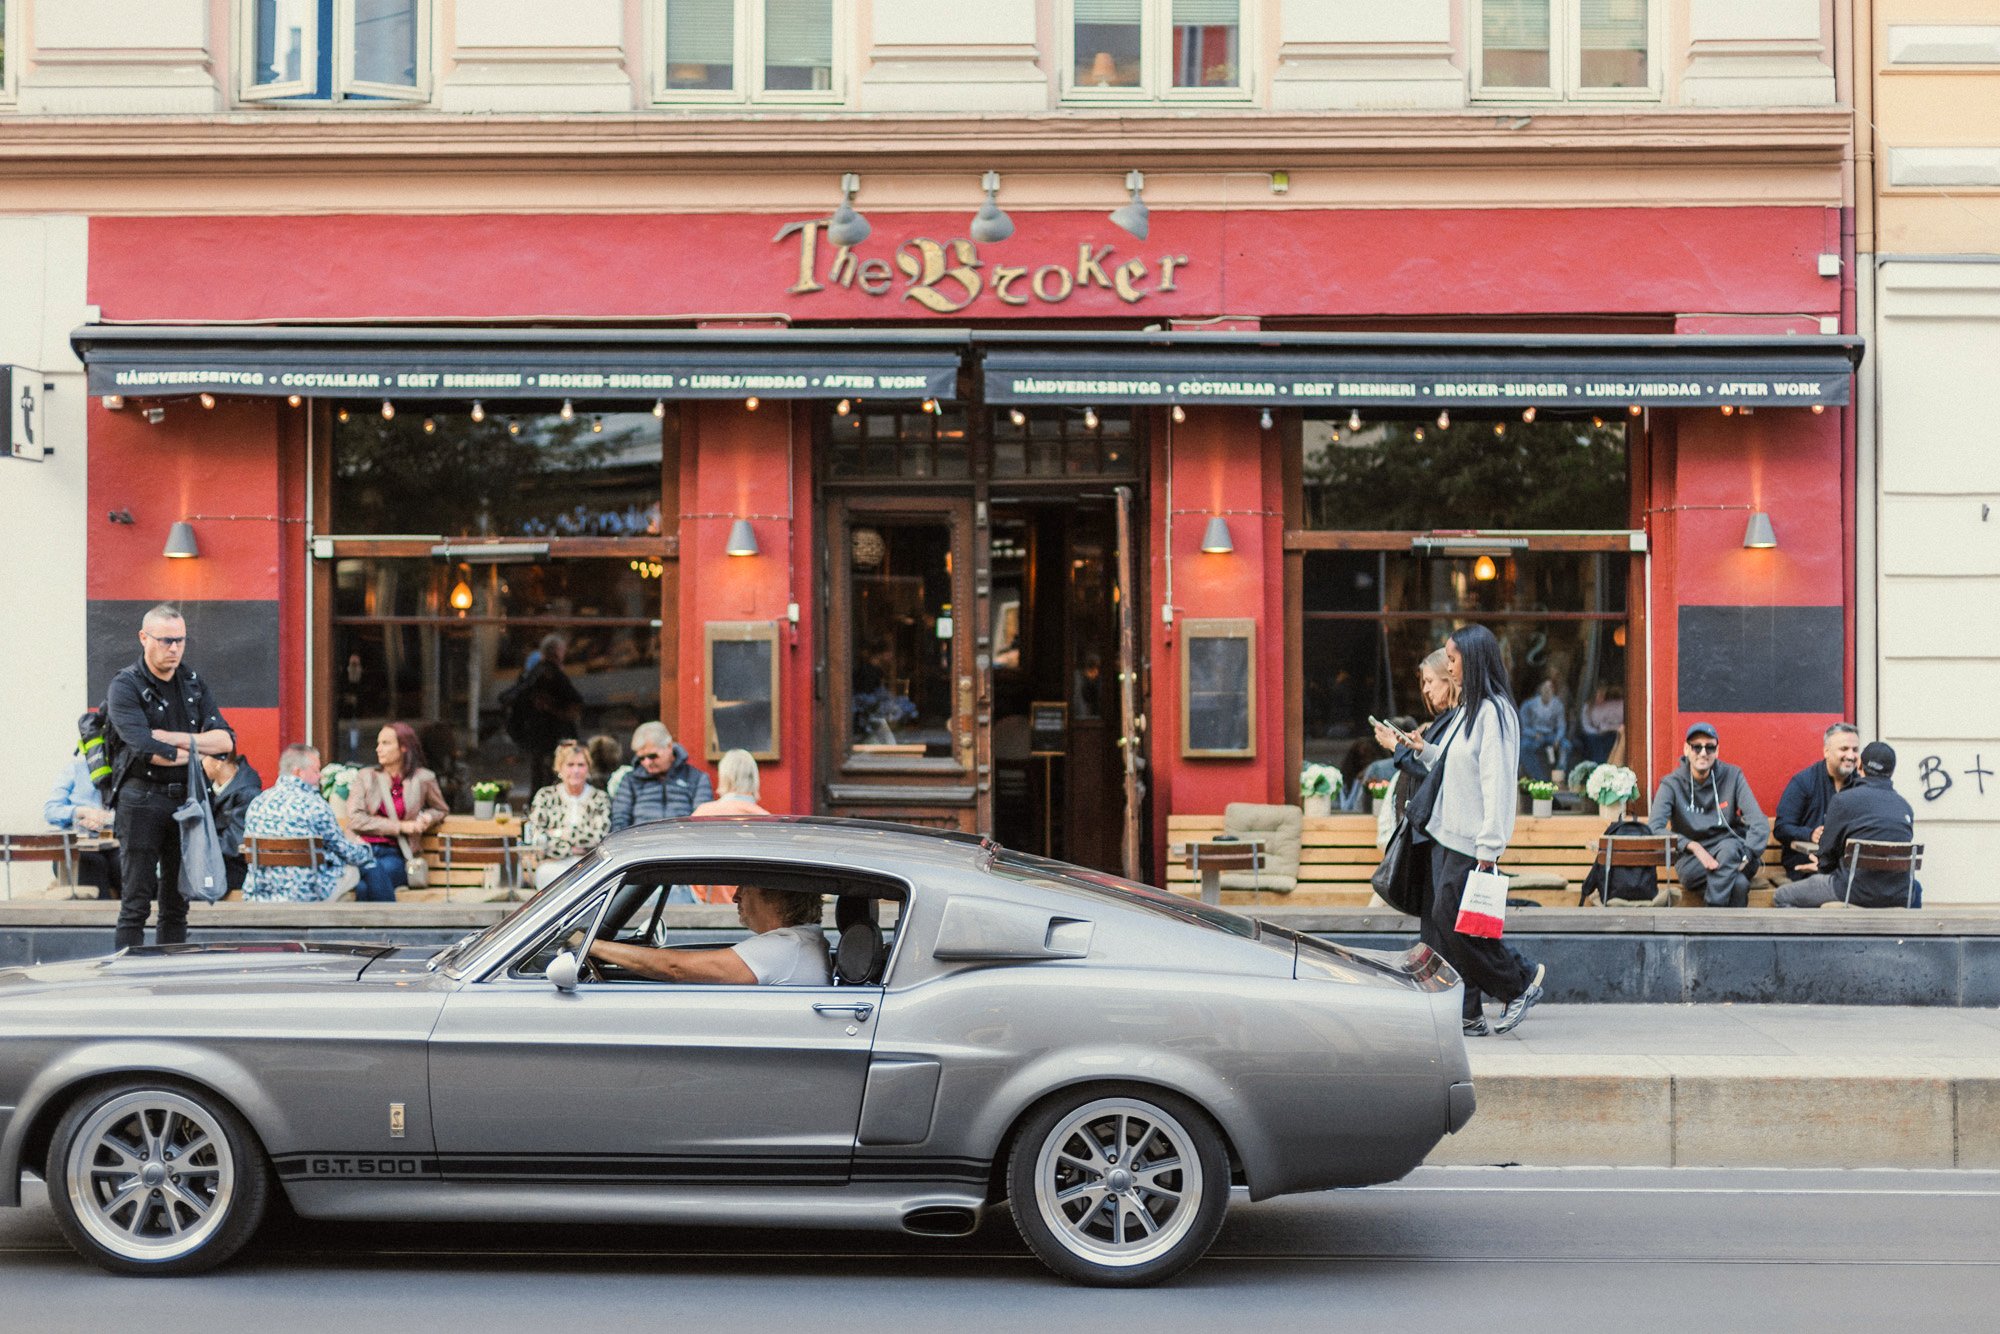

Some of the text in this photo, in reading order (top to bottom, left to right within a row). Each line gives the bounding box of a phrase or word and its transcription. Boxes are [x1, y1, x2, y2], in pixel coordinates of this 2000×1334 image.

[773, 217, 1188, 313] The Broker
[115, 368, 264, 386] HÅNDVERKSBRYGG
[281, 373, 380, 387] COCTAILBAR
[397, 373, 440, 388] EGET
[443, 373, 522, 388] BRENNERI
[538, 373, 674, 388] BROKER-BURGER
[823, 374, 875, 389] AFTER
[878, 375, 928, 389] WORK
[1013, 377, 1162, 395] HÅNDVERKSBRYGG
[1178, 381, 1276, 396] COCTAILBAR
[1292, 382, 1335, 396] EGET
[1338, 382, 1416, 397] BRENNERI
[1434, 383, 1568, 397] BROKER-BURGER
[1718, 382, 1769, 396] AFTER
[1773, 382, 1822, 396] WORK
